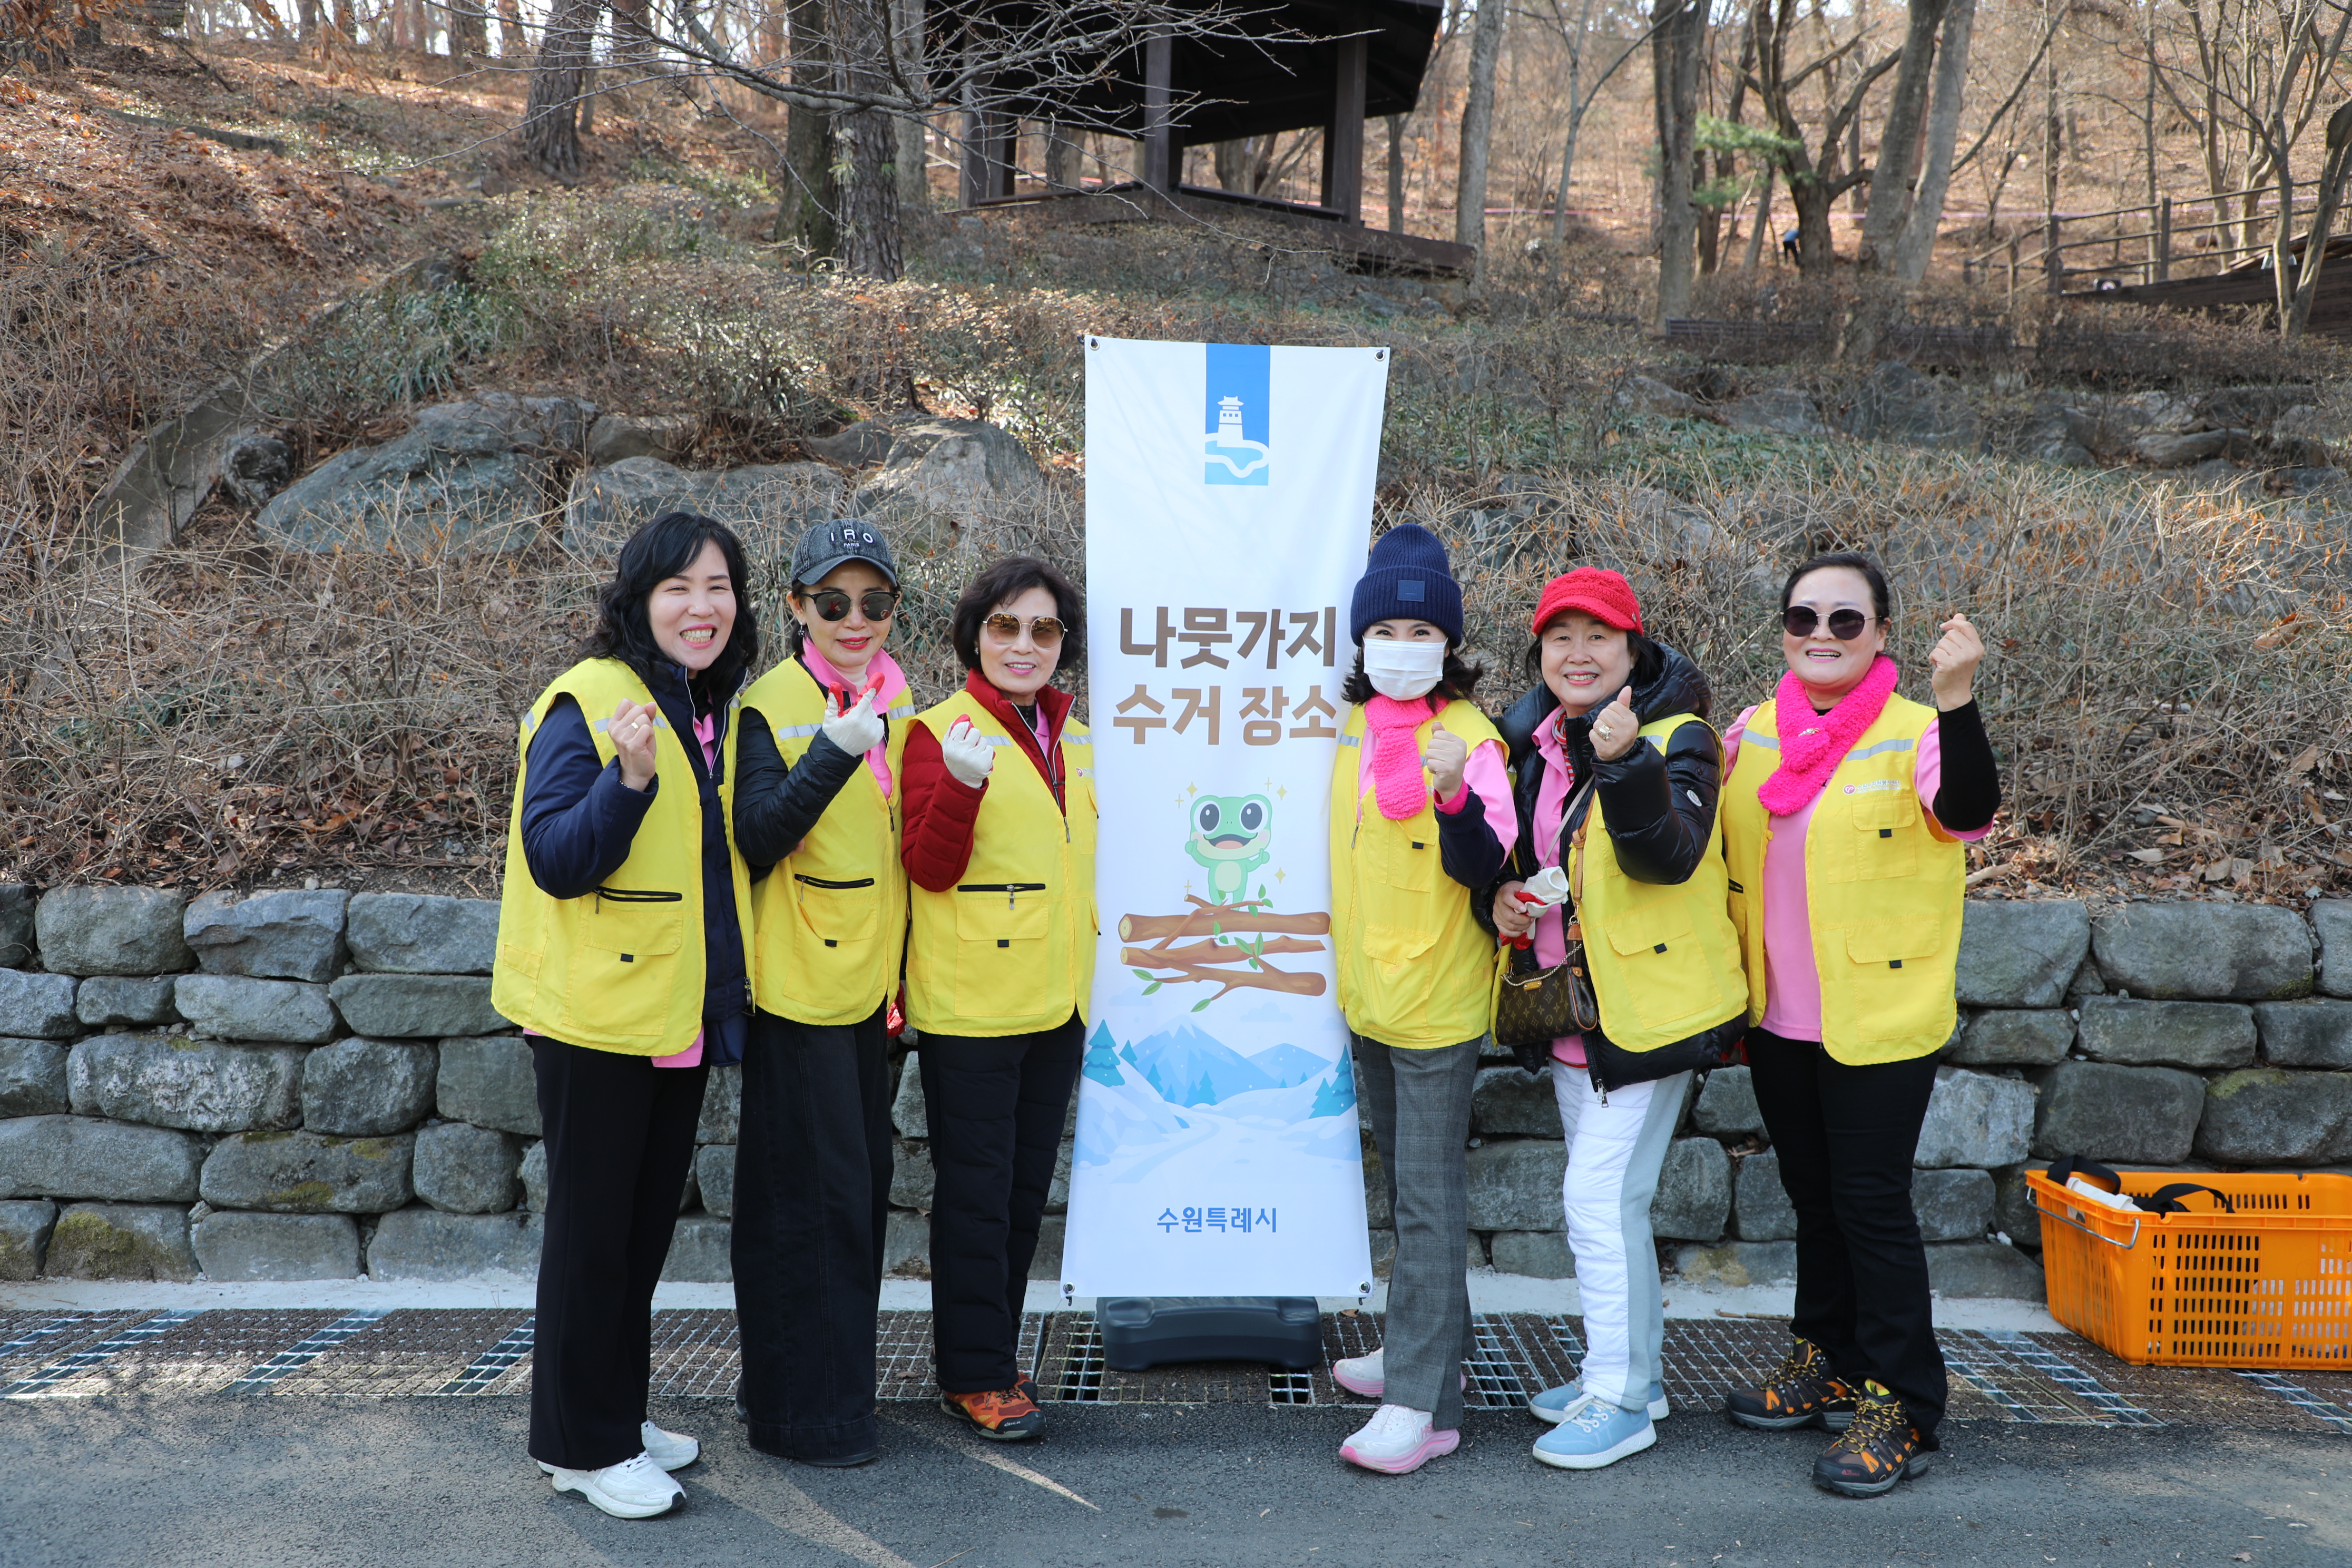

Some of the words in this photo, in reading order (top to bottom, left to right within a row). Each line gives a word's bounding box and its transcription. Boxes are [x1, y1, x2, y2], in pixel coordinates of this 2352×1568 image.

[830, 528, 874, 544] IRO
[1120, 606, 1337, 670] 나뭇가지
[1113, 684, 1221, 746] 수거
[1239, 685, 1337, 746] 장소
[1157, 1207, 1276, 1233] 수원특례시
